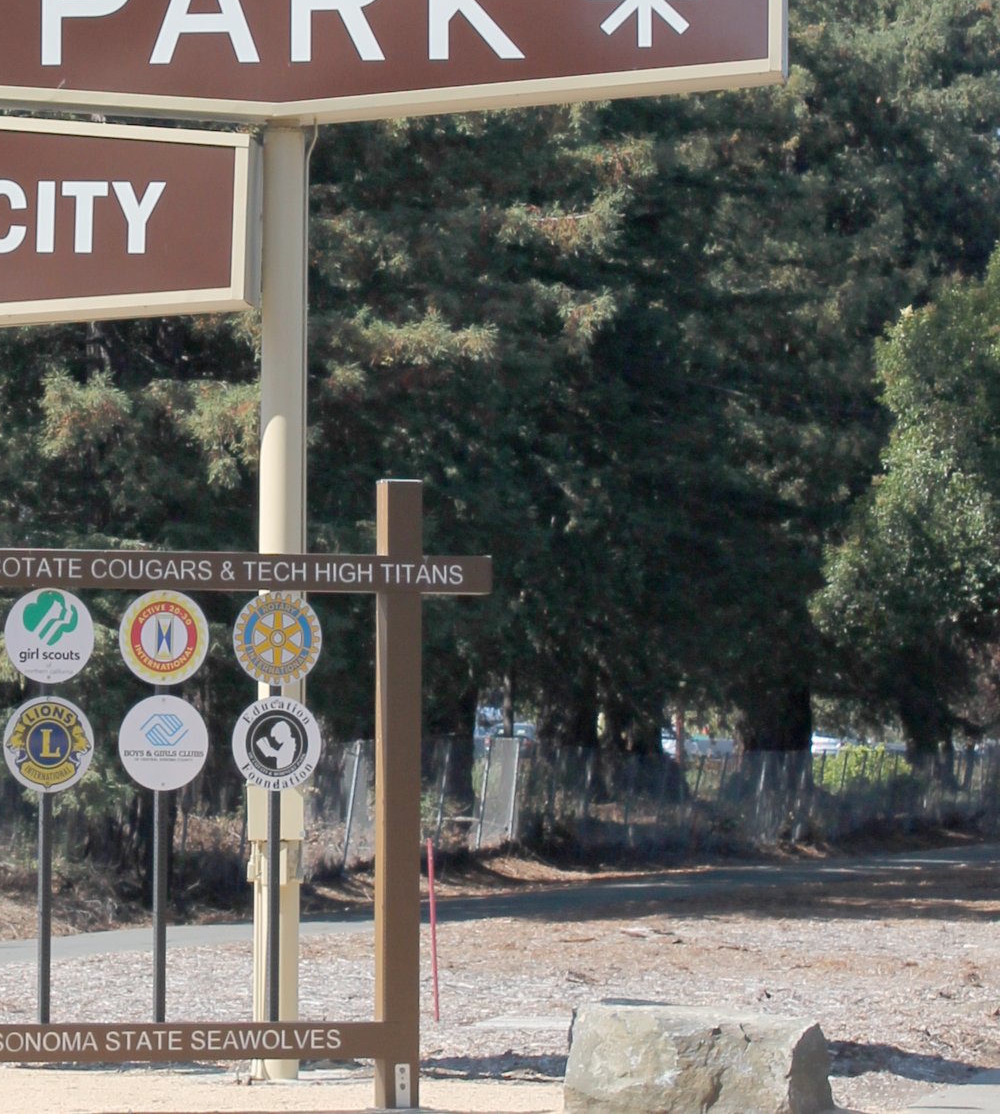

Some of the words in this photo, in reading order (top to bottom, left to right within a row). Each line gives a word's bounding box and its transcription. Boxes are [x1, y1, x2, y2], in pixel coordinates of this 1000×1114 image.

[91, 558, 212, 581] COUGARS
[220, 561, 235, 580] &
[243, 561, 306, 582] TECH
[315, 563, 373, 583] HIGH
[380, 563, 463, 584] TITANS
[138, 605, 166, 624] ACTIVE
[169, 605, 192, 626] 20-30
[262, 602, 296, 614] ROTARY
[19, 647, 39, 663] girl
[42, 650, 80, 660] scouts
[135, 644, 194, 671] INTERNATIONAL
[247, 646, 309, 675] INTERNATIONAL
[25, 706, 74, 725] LIONS
[243, 700, 310, 725] Education
[40, 729, 60, 757] L
[179, 750, 204, 758] CLUBS
[25, 766, 72, 781] INTERNATIONAL
[242, 763, 312, 789] Foundation
[105, 1030, 183, 1051] STATE
[191, 1029, 342, 1050] SEAWOLVES
